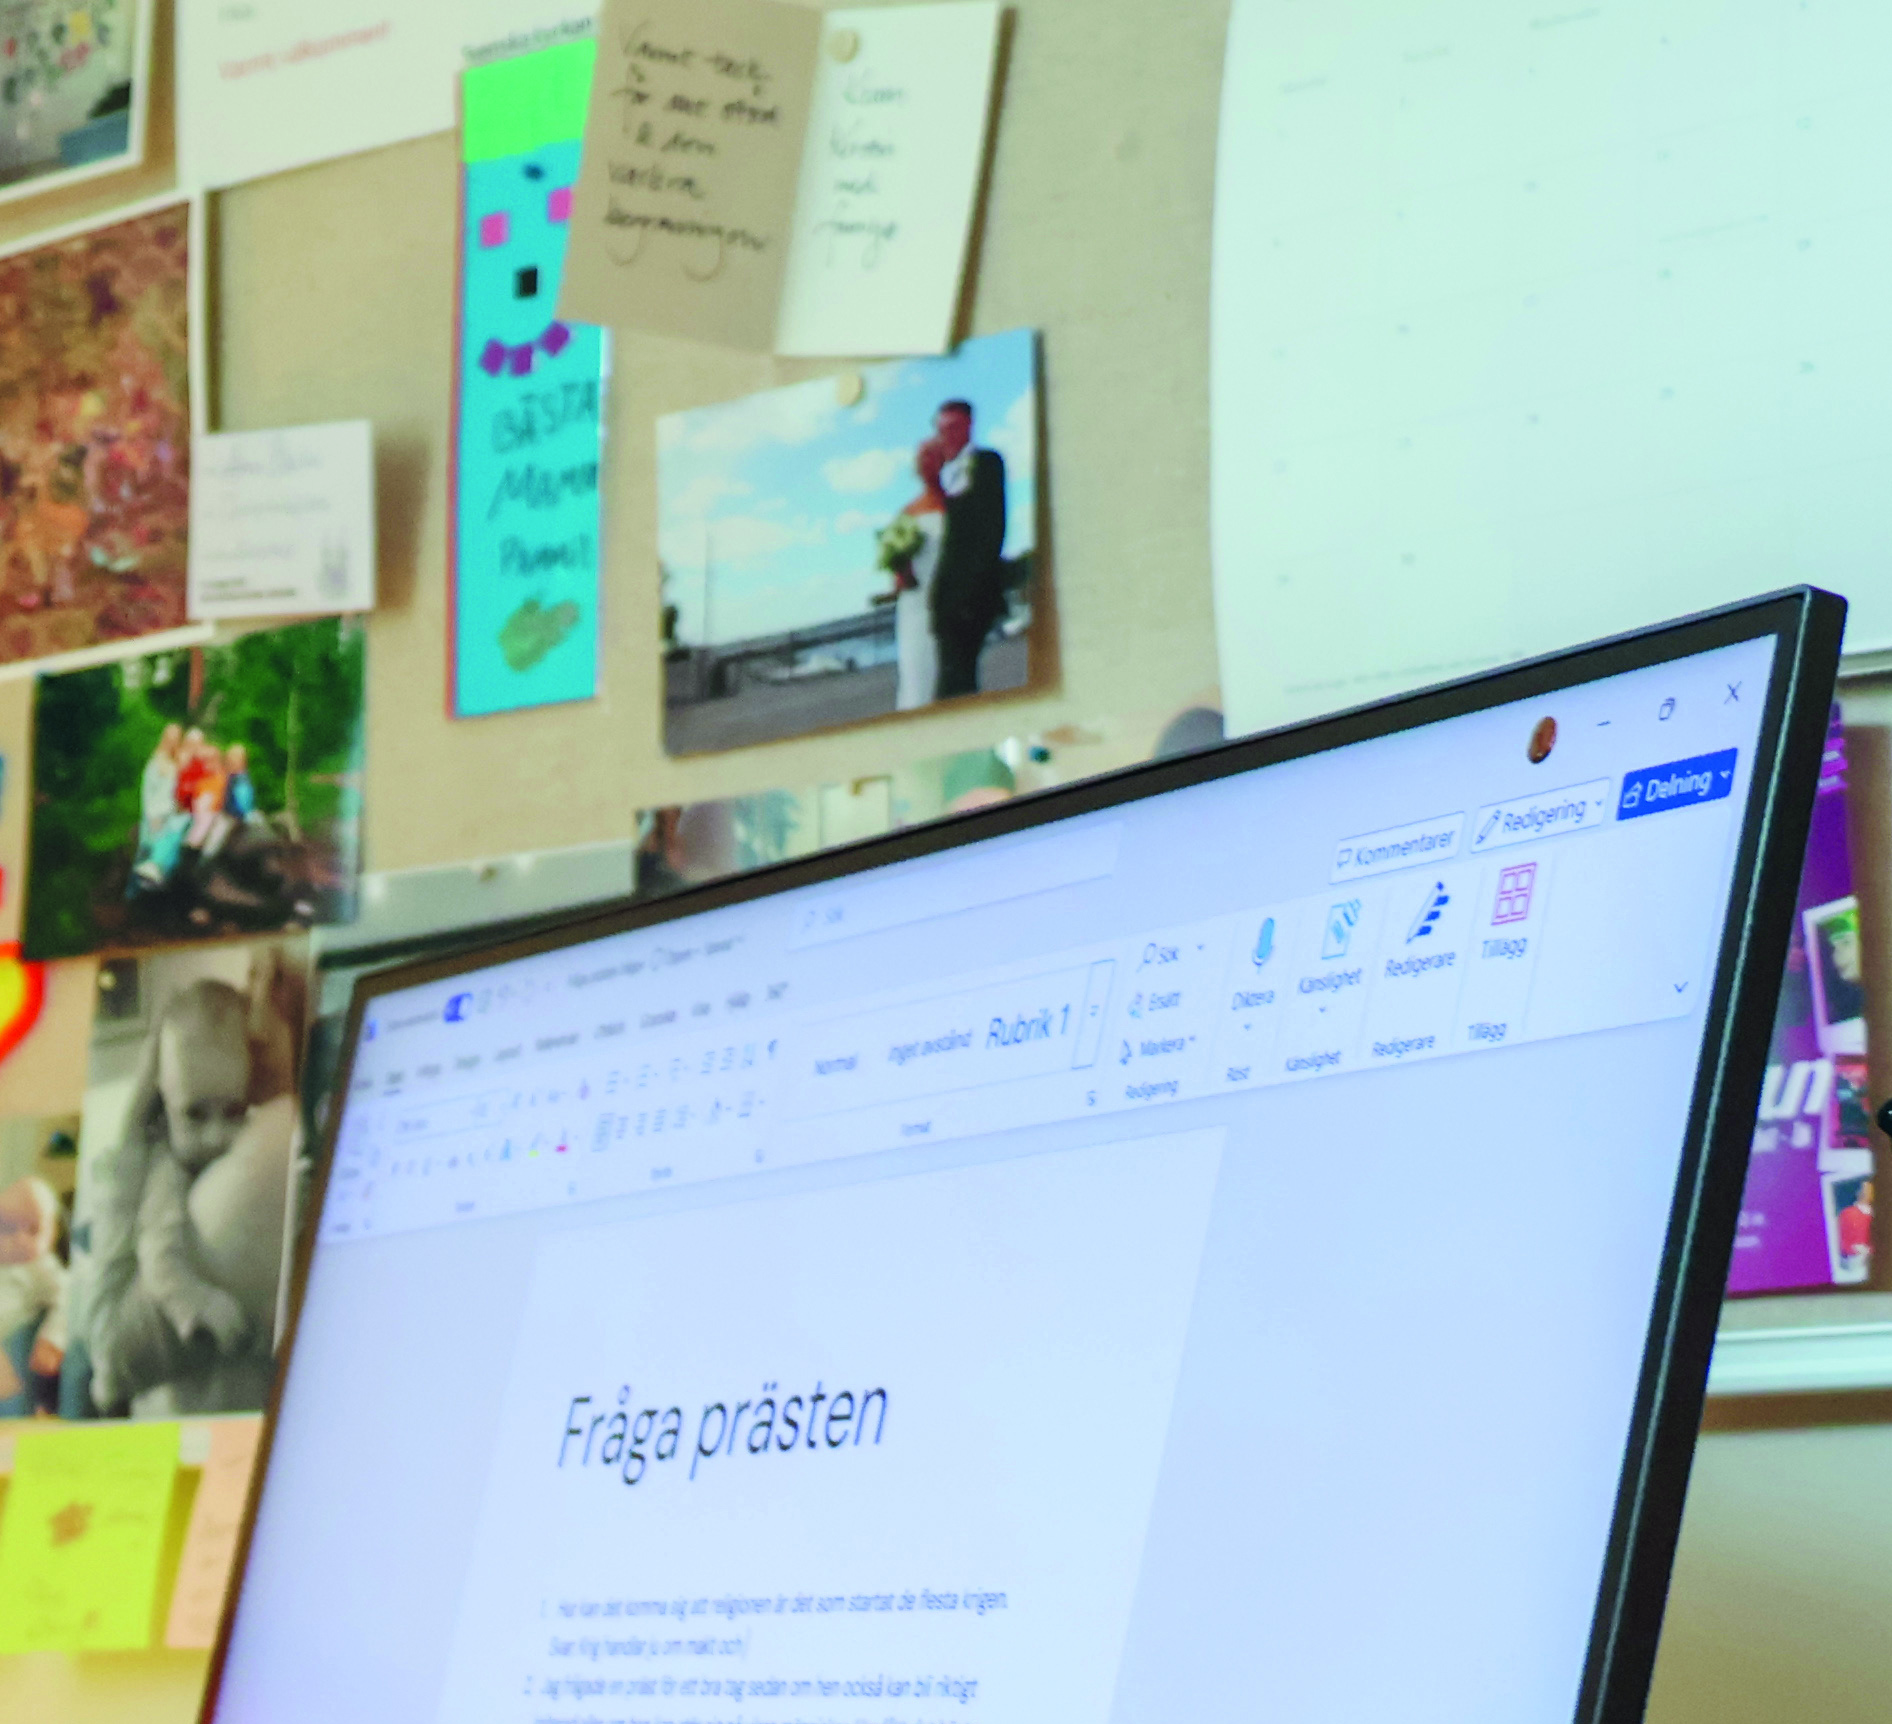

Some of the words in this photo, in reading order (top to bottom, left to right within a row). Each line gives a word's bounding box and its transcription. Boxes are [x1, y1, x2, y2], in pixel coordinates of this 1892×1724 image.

[1646, 766, 1713, 803] Delning
[1503, 799, 1588, 834] Redigering
[1355, 829, 1455, 868] Kommentarer
[985, 1006, 1054, 1049] Rubrik
[1060, 1003, 1071, 1035] 1
[558, 1384, 682, 1487] Fråga
[689, 1380, 888, 1482] prästen
